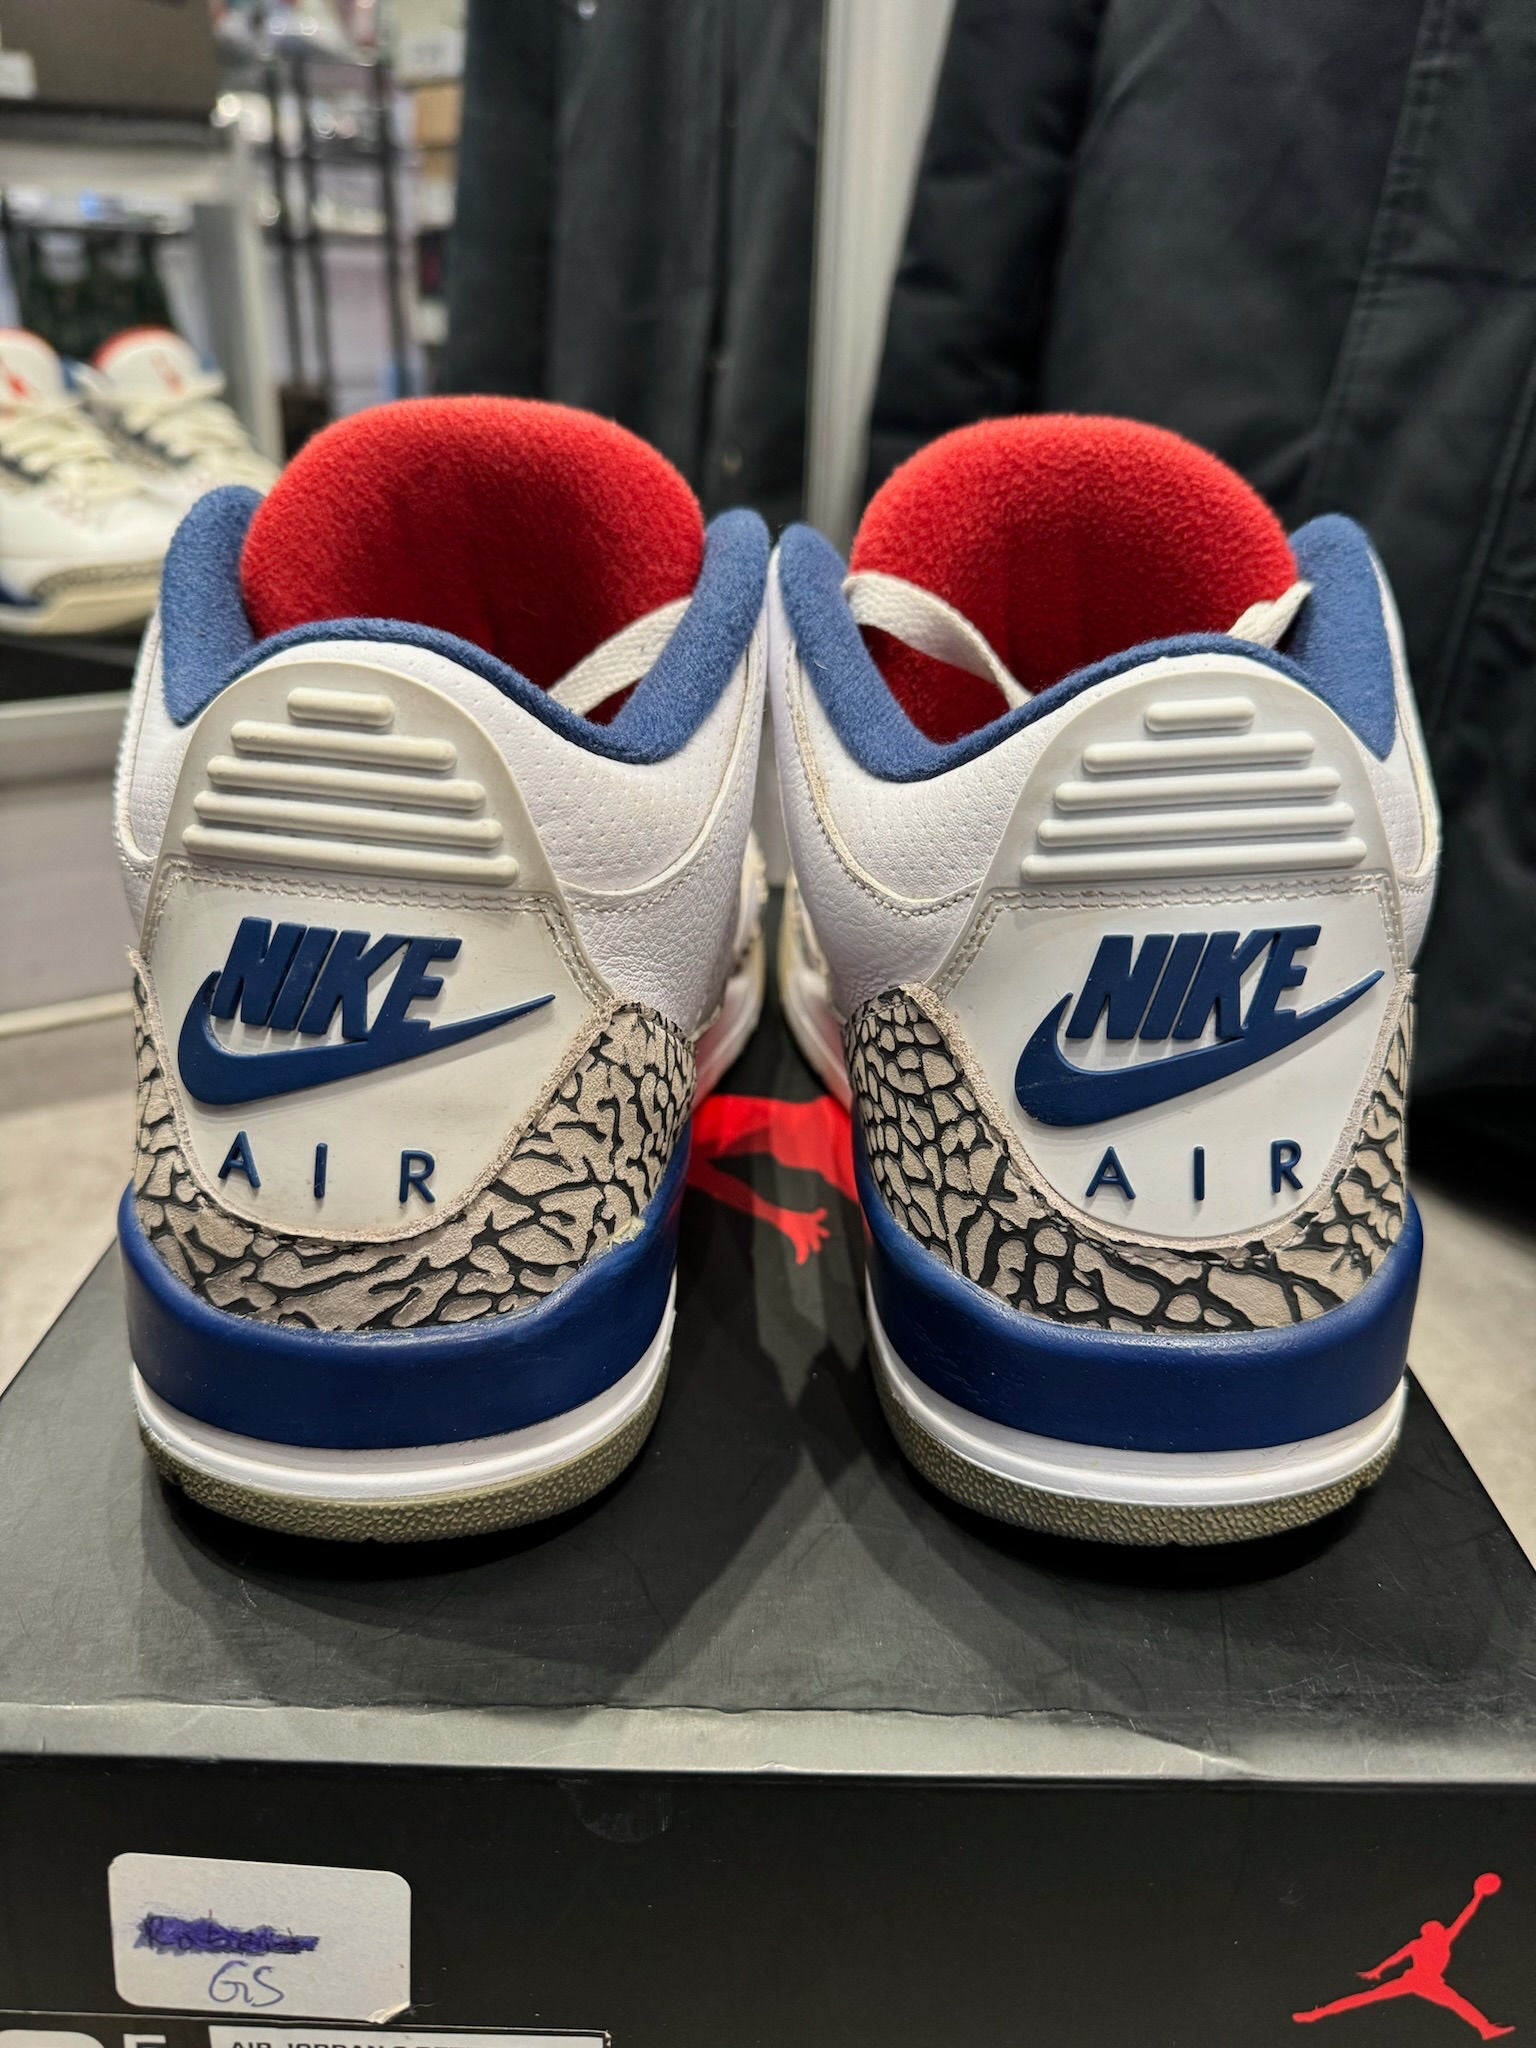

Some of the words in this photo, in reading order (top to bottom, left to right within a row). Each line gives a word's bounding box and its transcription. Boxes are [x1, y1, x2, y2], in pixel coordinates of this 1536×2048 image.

[210, 916, 463, 1040] NIKE
[1064, 924, 1322, 1040] NIKE
[217, 1130, 436, 1204] AIR
[1085, 1138, 1304, 1201] AIR
[208, 1959, 285, 2008] GS
